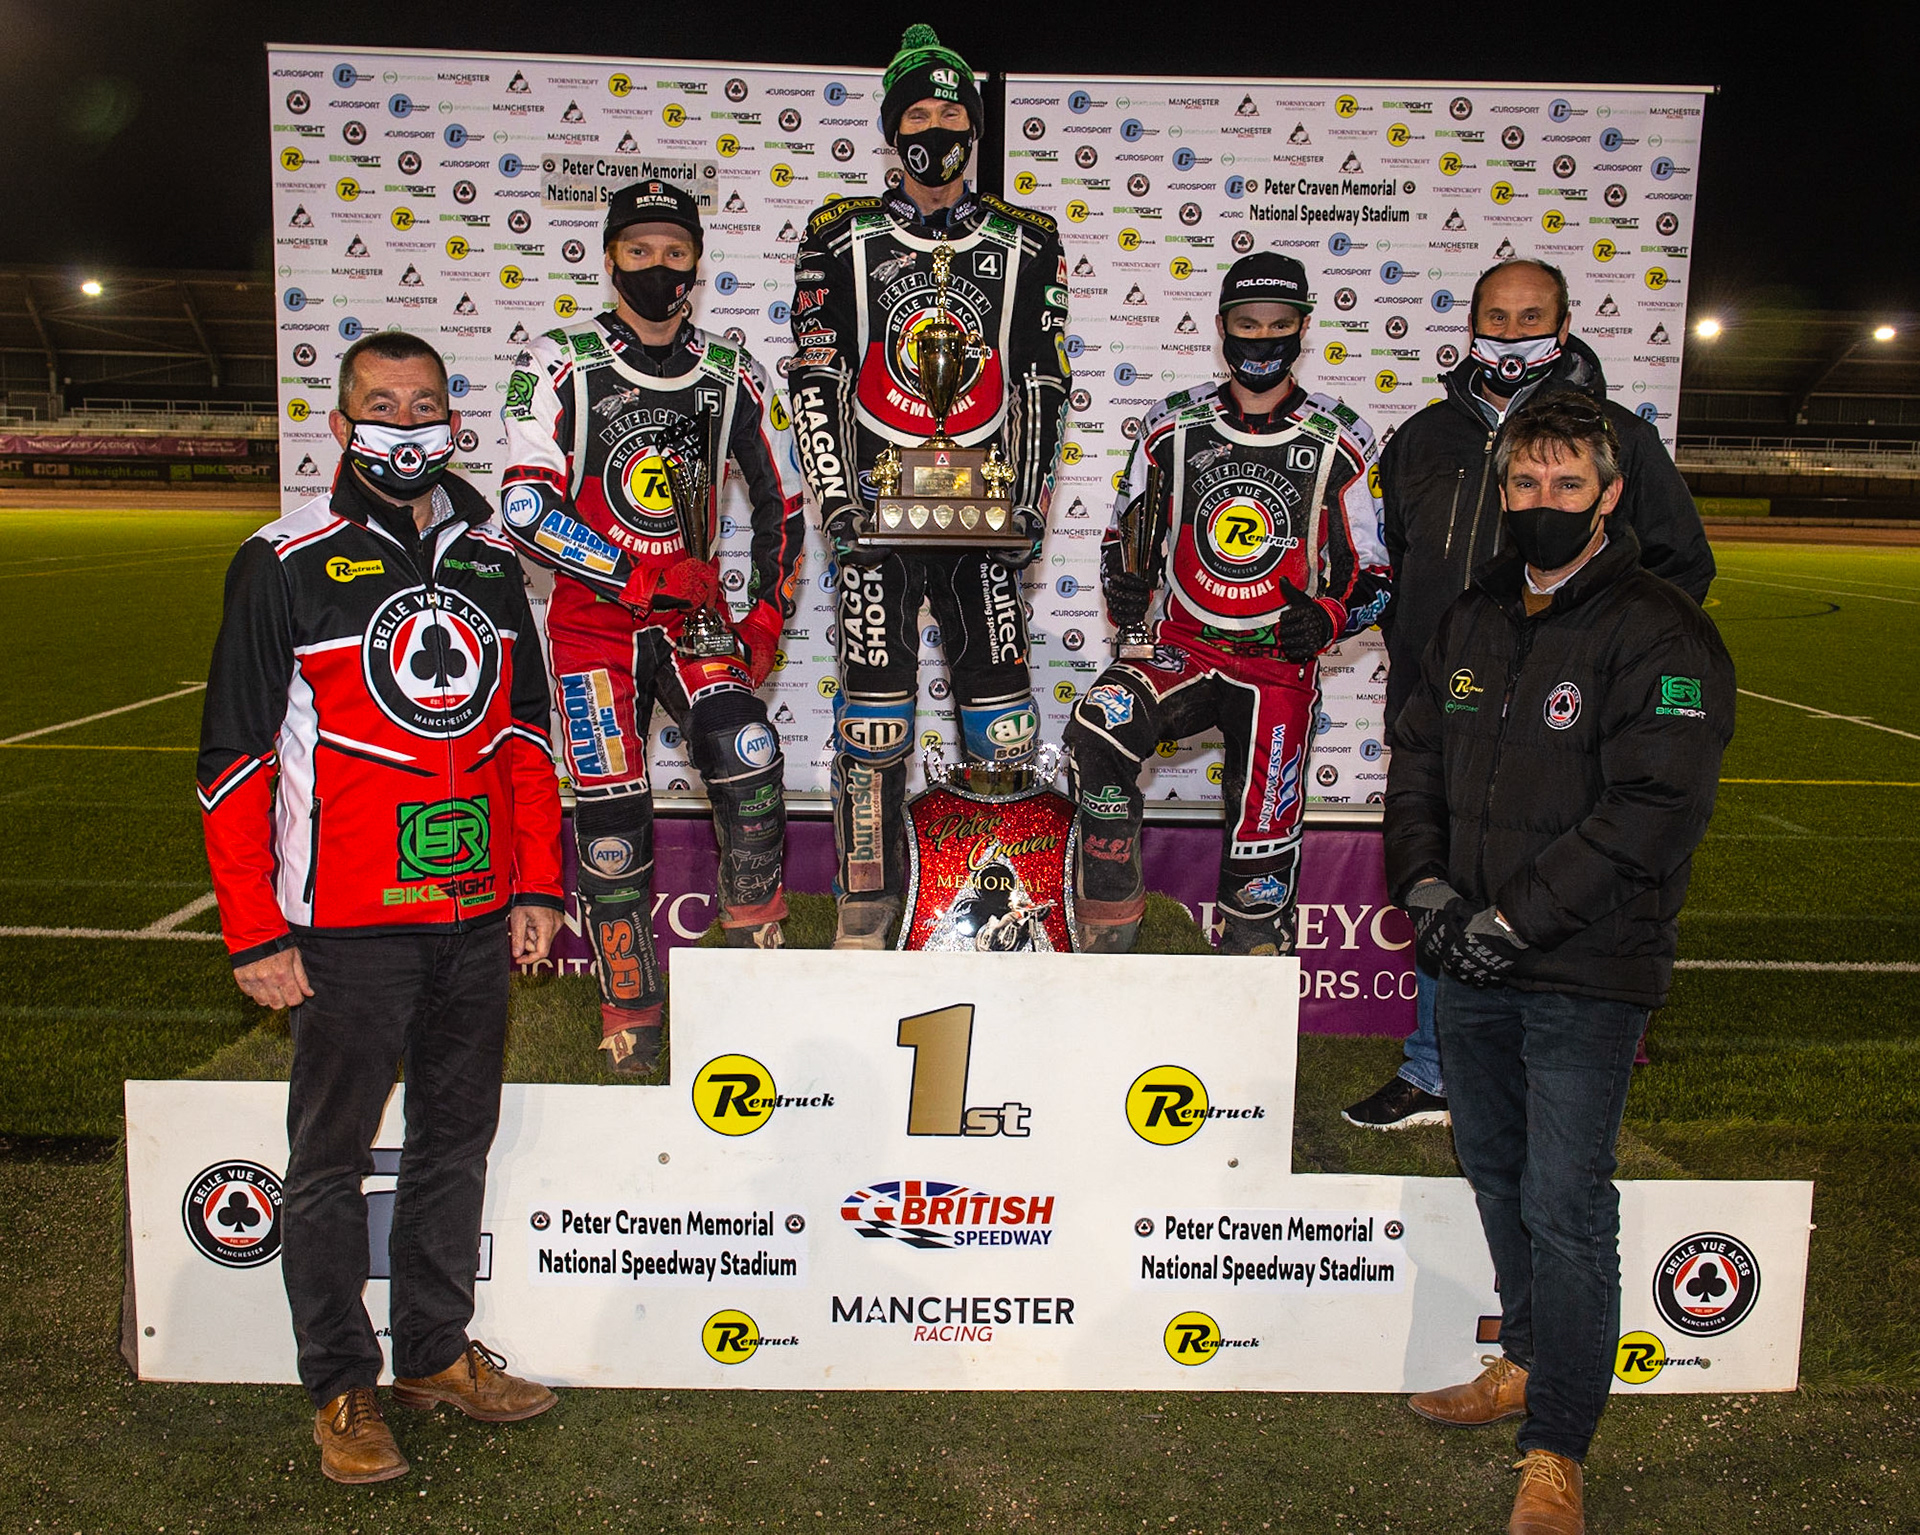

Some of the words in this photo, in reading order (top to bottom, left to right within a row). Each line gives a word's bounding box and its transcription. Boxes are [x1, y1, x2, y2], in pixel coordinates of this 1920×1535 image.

[438, 74, 489, 82] MANCHESTER
[934, 88, 959, 101] BOLL
[1169, 98, 1219, 106] MANCHESTER
[562, 159, 594, 175] Peter
[596, 159, 638, 178] Craven
[642, 162, 697, 180] Memorial
[548, 184, 597, 202] National
[636, 194, 677, 205] BETARD
[1265, 178, 1295, 195] Peter
[1298, 178, 1339, 195] Craven
[1341, 179, 1396, 196] Memorial
[710, 223, 761, 231] MANCHESTER
[813, 210, 838, 227] TRU
[837, 199, 876, 215] PLANT
[1250, 204, 1298, 221] National
[1301, 204, 1359, 226] Speedway
[1362, 205, 1409, 222] Stadium
[277, 238, 328, 246] MANCHESTER
[978, 255, 998, 276] 4
[878, 271, 928, 310] PETER
[929, 271, 993, 315] CAVEN
[1236, 278, 1298, 290] POLCOPPER
[387, 297, 437, 305] MANCHESTER
[892, 300, 921, 332] BELLE
[955, 307, 978, 331] ACE
[1162, 344, 1211, 352] MANCHESTER
[698, 390, 720, 417] 15
[886, 388, 976, 418] MEMIAL
[600, 409, 652, 446] PETER
[612, 436, 645, 469] BELLE
[802, 386, 848, 499] HAGON
[1289, 447, 1315, 470] 10
[1192, 462, 1240, 496] PETER
[1241, 462, 1301, 506] CRAVEN
[509, 498, 533, 514] ATPI
[1200, 487, 1231, 517] BELLE
[1236, 485, 1262, 499] VUE
[1264, 497, 1285, 526] ACES
[542, 510, 621, 559] ALBON
[608, 524, 684, 555] MEMORI
[1225, 516, 1299, 549] Rentruck
[562, 545, 587, 563] plc
[1213, 561, 1258, 575] MANCHESTER
[330, 562, 381, 577] Rentruck
[980, 562, 989, 579] the
[1195, 568, 1275, 600] MEMORIAL
[981, 579, 994, 616] training
[988, 560, 1019, 662] oultec
[372, 601, 411, 651] BELLE
[413, 592, 454, 610] VUE
[459, 606, 494, 646] ACES
[841, 565, 867, 666] HAGO
[863, 564, 889, 668] SHOCK
[987, 616, 1000, 665] specialists
[561, 674, 603, 774] ALBON
[599, 707, 621, 738] plc
[746, 734, 769, 755] ATPI
[996, 739, 1033, 759] BOLL
[1082, 797, 1113, 813] ROCK
[926, 810, 1002, 851] Peter
[596, 849, 623, 861] ATPI
[967, 834, 1058, 871] Craven
[383, 876, 495, 906] BIKERIGHT
[937, 874, 1046, 893] MEMORIAL
[601, 920, 640, 999] CFS
[897, 1003, 1031, 1136] 1st
[707, 1073, 835, 1117] Rentruck
[1141, 1084, 1265, 1127] Rentruck
[193, 1173, 224, 1205] BELLE
[228, 1169, 255, 1181] VUE
[258, 1178, 283, 1206] ACES
[562, 1209, 611, 1234] Peter
[616, 1209, 682, 1235] Craven
[687, 1211, 774, 1236] Memorial
[901, 1196, 1055, 1225] BRITISH
[954, 1230, 1052, 1246] SPEEDWAY
[1165, 1215, 1213, 1240] Peter
[1218, 1216, 1282, 1241] Craven
[1287, 1216, 1373, 1242] Memorial
[216, 1246, 263, 1258] MANCHESTER
[539, 1248, 616, 1274] National
[621, 1249, 716, 1281] Speedway
[721, 1251, 797, 1276] Stadium
[1665, 1245, 1697, 1275] BELLE
[1701, 1241, 1727, 1253] VUE
[1728, 1250, 1750, 1277] ACES
[1141, 1255, 1217, 1280] National
[1222, 1255, 1315, 1287] Speedway
[1319, 1256, 1394, 1282] Stadium
[832, 1296, 1074, 1325] MANCHESTER
[1681, 1316, 1726, 1327] MANCHESTER
[712, 1322, 799, 1352] Rentruck
[913, 1325, 993, 1342] RACING
[1175, 1324, 1260, 1354] Rentruck
[1621, 1343, 1703, 1373] Rentruck
